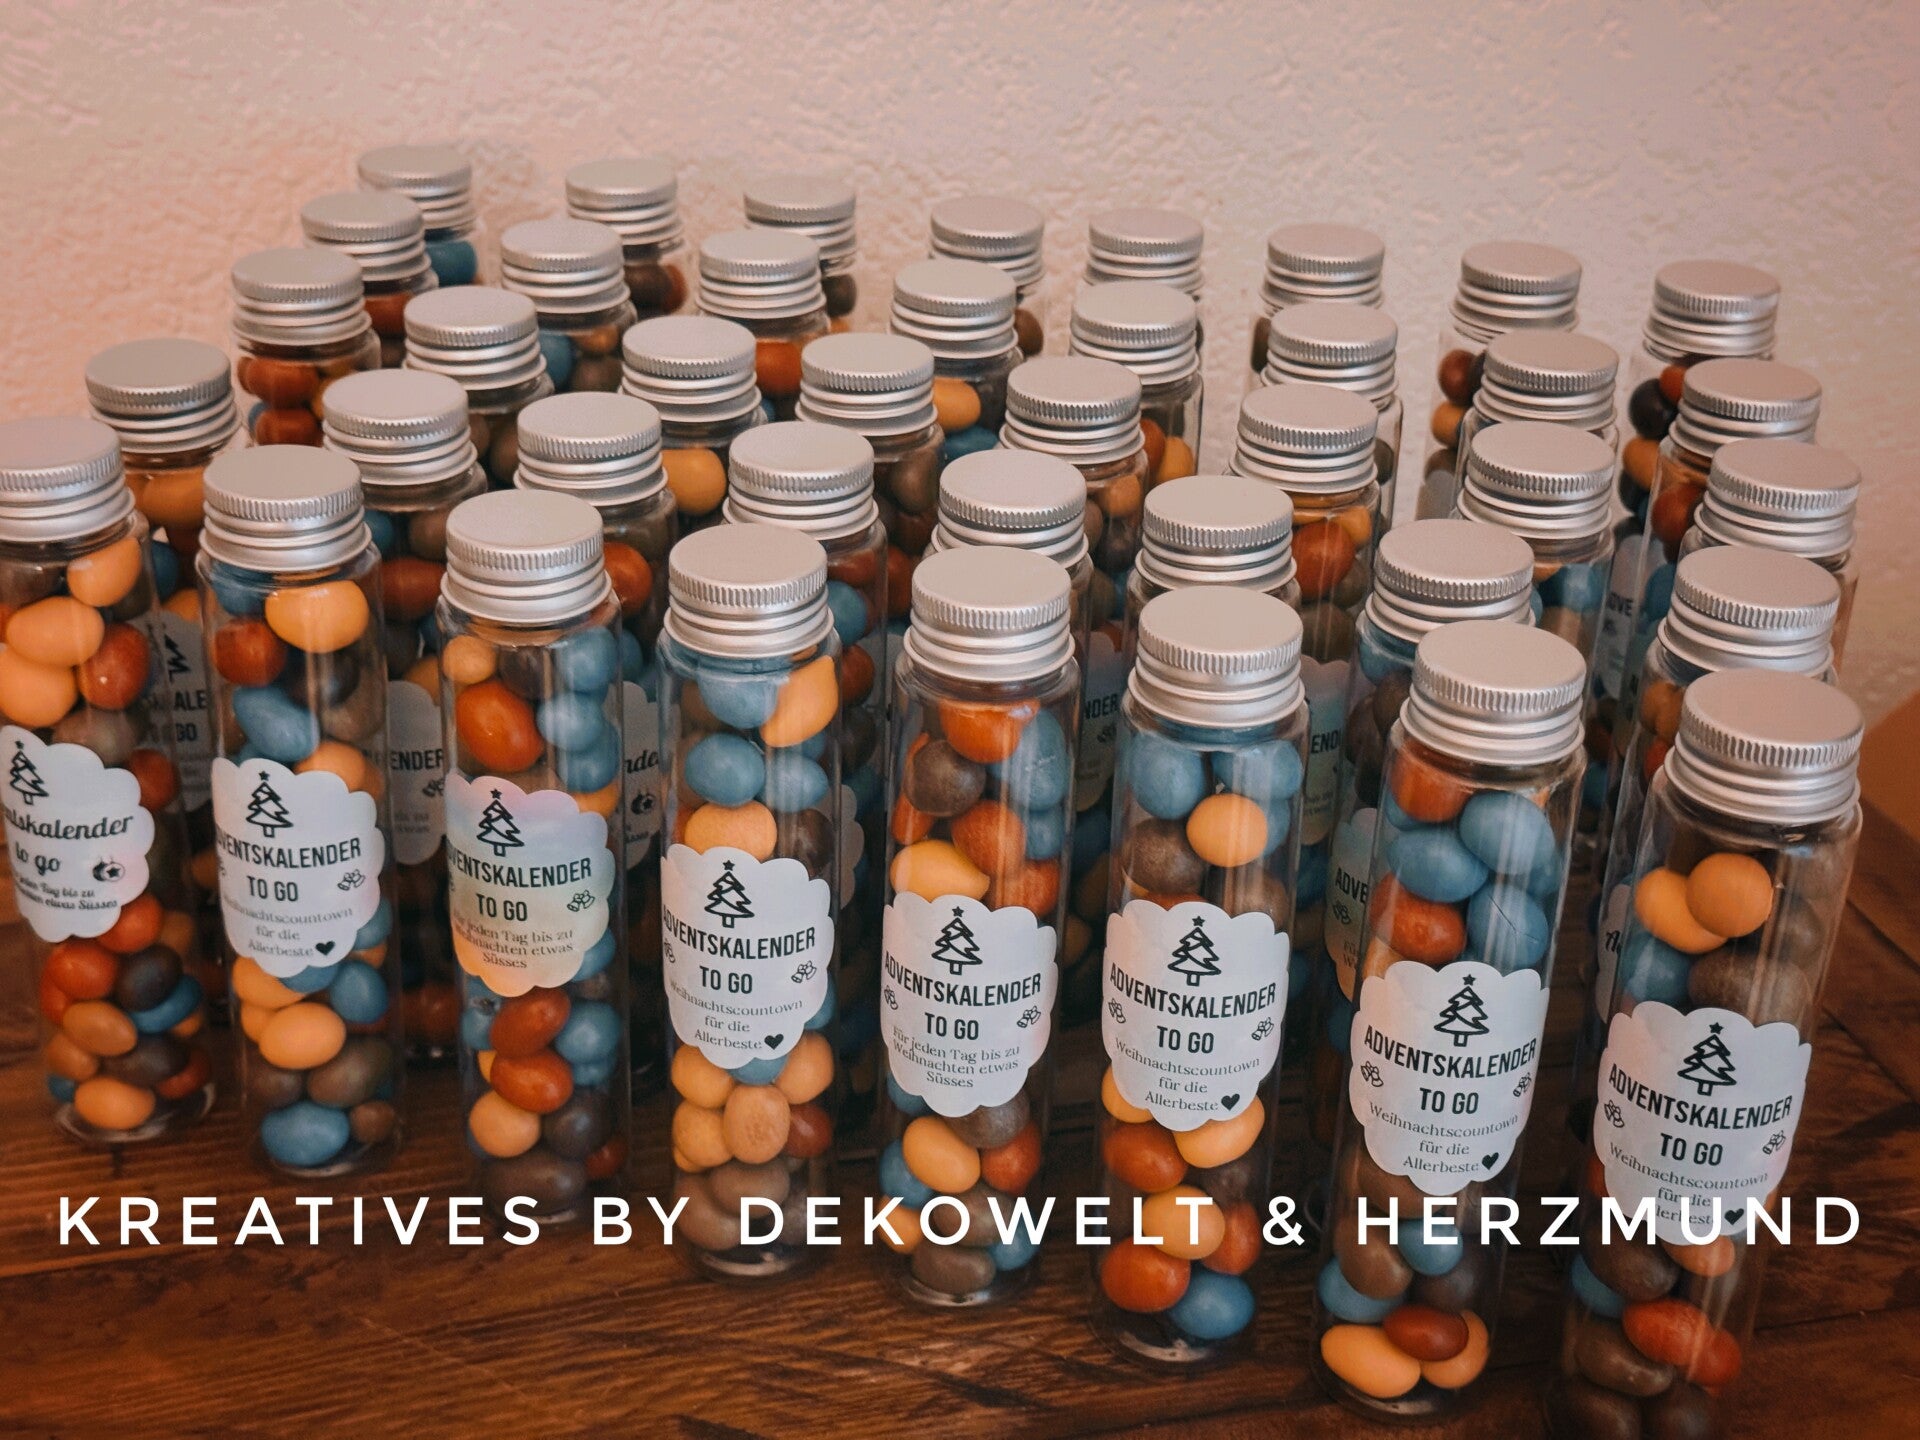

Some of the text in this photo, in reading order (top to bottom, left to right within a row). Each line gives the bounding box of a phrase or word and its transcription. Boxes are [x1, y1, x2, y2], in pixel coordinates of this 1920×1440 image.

[35, 855, 61, 877] go
[247, 875, 298, 902] TO GO
[476, 893, 497, 918] TO
[503, 901, 528, 921] GO
[278, 928, 300, 941] die
[502, 930, 528, 945] Tag
[532, 930, 553, 942] bis
[557, 929, 573, 939] zu
[663, 904, 815, 960] ADVENTSKALENDER
[532, 945, 574, 956] etwas
[699, 965, 753, 994] TO GO
[885, 951, 1041, 1007] ADVENTSKALENDER
[1110, 963, 1276, 1019] ADVENTSKALENDER
[704, 1015, 750, 1032] für die
[924, 1012, 979, 1040] TO GO
[694, 1029, 762, 1050] Allerbeste
[910, 1037, 946, 1058] jeden
[950, 1049, 977, 1064] Tag
[982, 1048, 1000, 1061] bis
[1005, 1046, 1020, 1057] zu
[1157, 1025, 1214, 1053] TO GO
[1364, 1024, 1537, 1079] ADVENTSKALENDER
[893, 1039, 1019, 1074] Weihnachten etwas
[1115, 1037, 1260, 1076] Weihnachtscountown
[926, 1071, 974, 1088] Süsses
[1159, 1076, 1208, 1093] für die
[1145, 1091, 1219, 1111] Allerbeste
[1419, 1087, 1479, 1114] TO GO
[1609, 1063, 1793, 1130] ADVENTSKALENDER
[1370, 1102, 1518, 1138] Weihnachtscountown
[1419, 1140, 1470, 1155] für die
[1660, 1132, 1723, 1166] TO GO
[1403, 1155, 1479, 1173] Allerbeste
